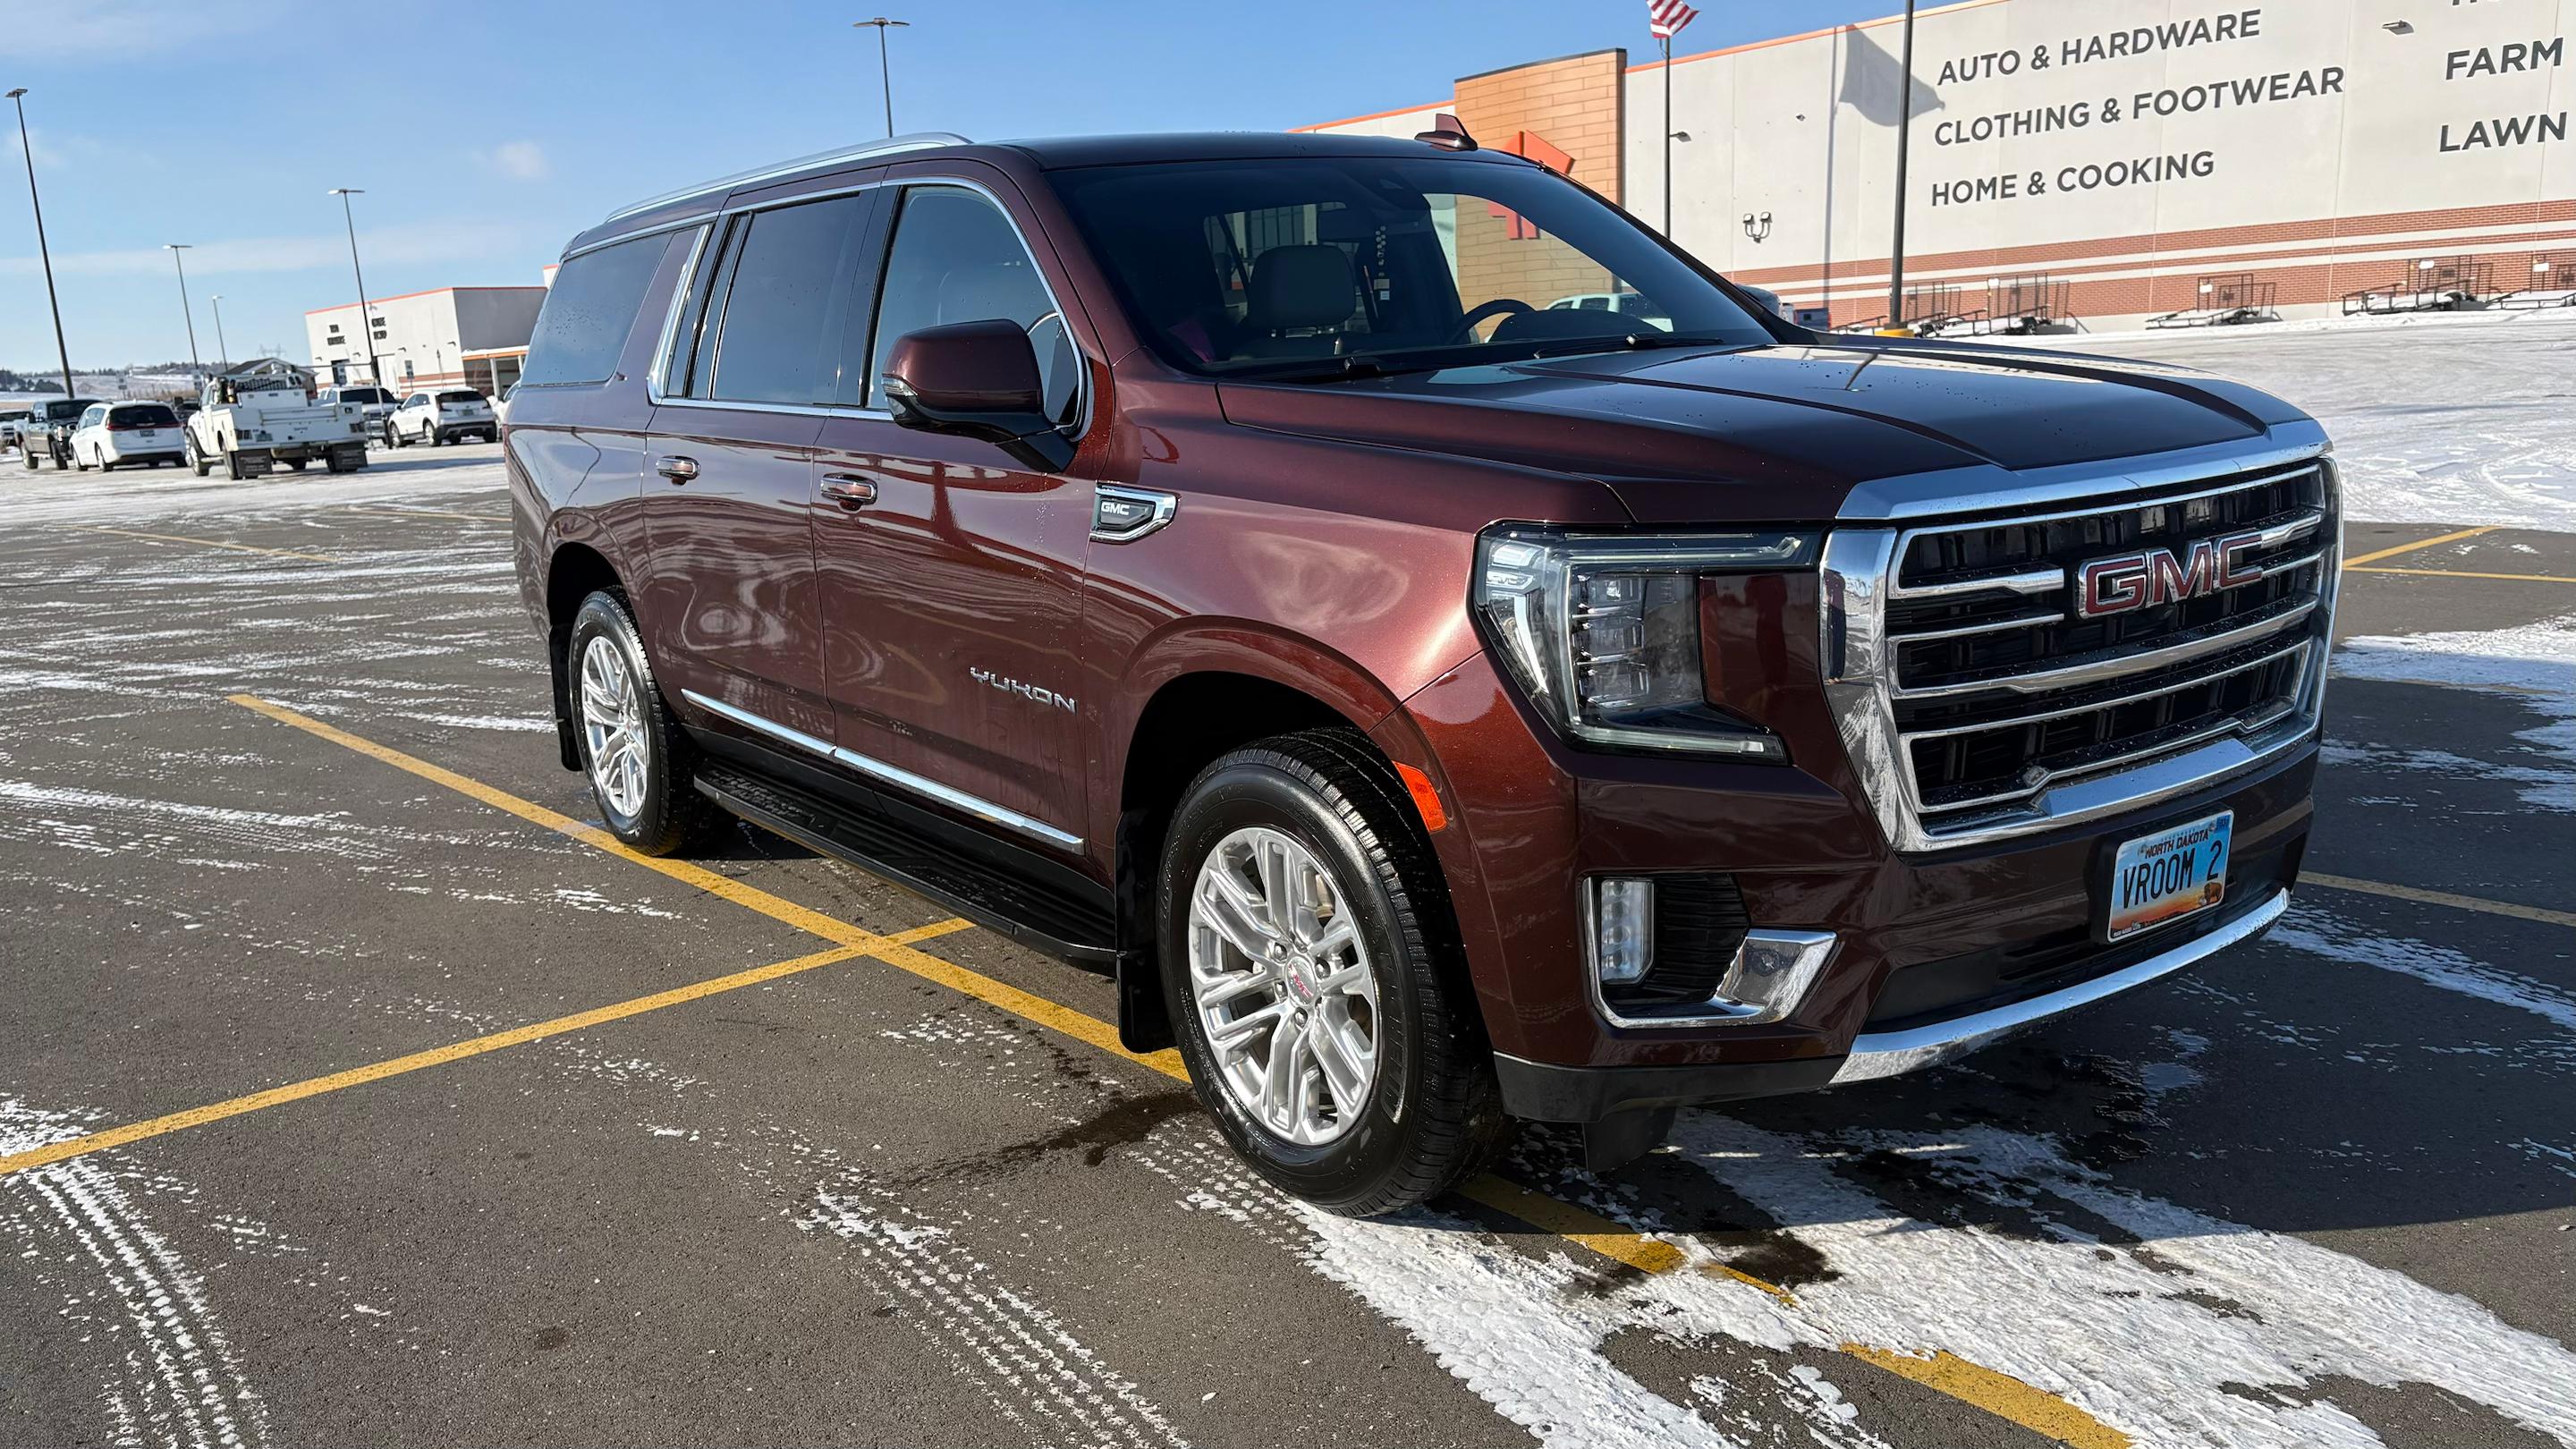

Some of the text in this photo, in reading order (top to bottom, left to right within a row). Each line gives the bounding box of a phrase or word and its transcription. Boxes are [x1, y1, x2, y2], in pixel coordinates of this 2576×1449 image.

[1937, 10, 2261, 86] AUTO & HARDWARE
[2445, 37, 2563, 80] FARM
[1935, 67, 2344, 146] CLOTHING & FOOTWEAR
[2439, 111, 2567, 153] LAWN
[1931, 150, 2214, 207] HOME & COOKING
[1101, 502, 1130, 515] GMC
[2078, 534, 2263, 619] GMC
[970, 666, 1078, 715] YUKON
[2145, 840, 2174, 859] NORTH
[2176, 829, 2208, 849] DAKOTA
[2123, 840, 2223, 909] VROOM 2
